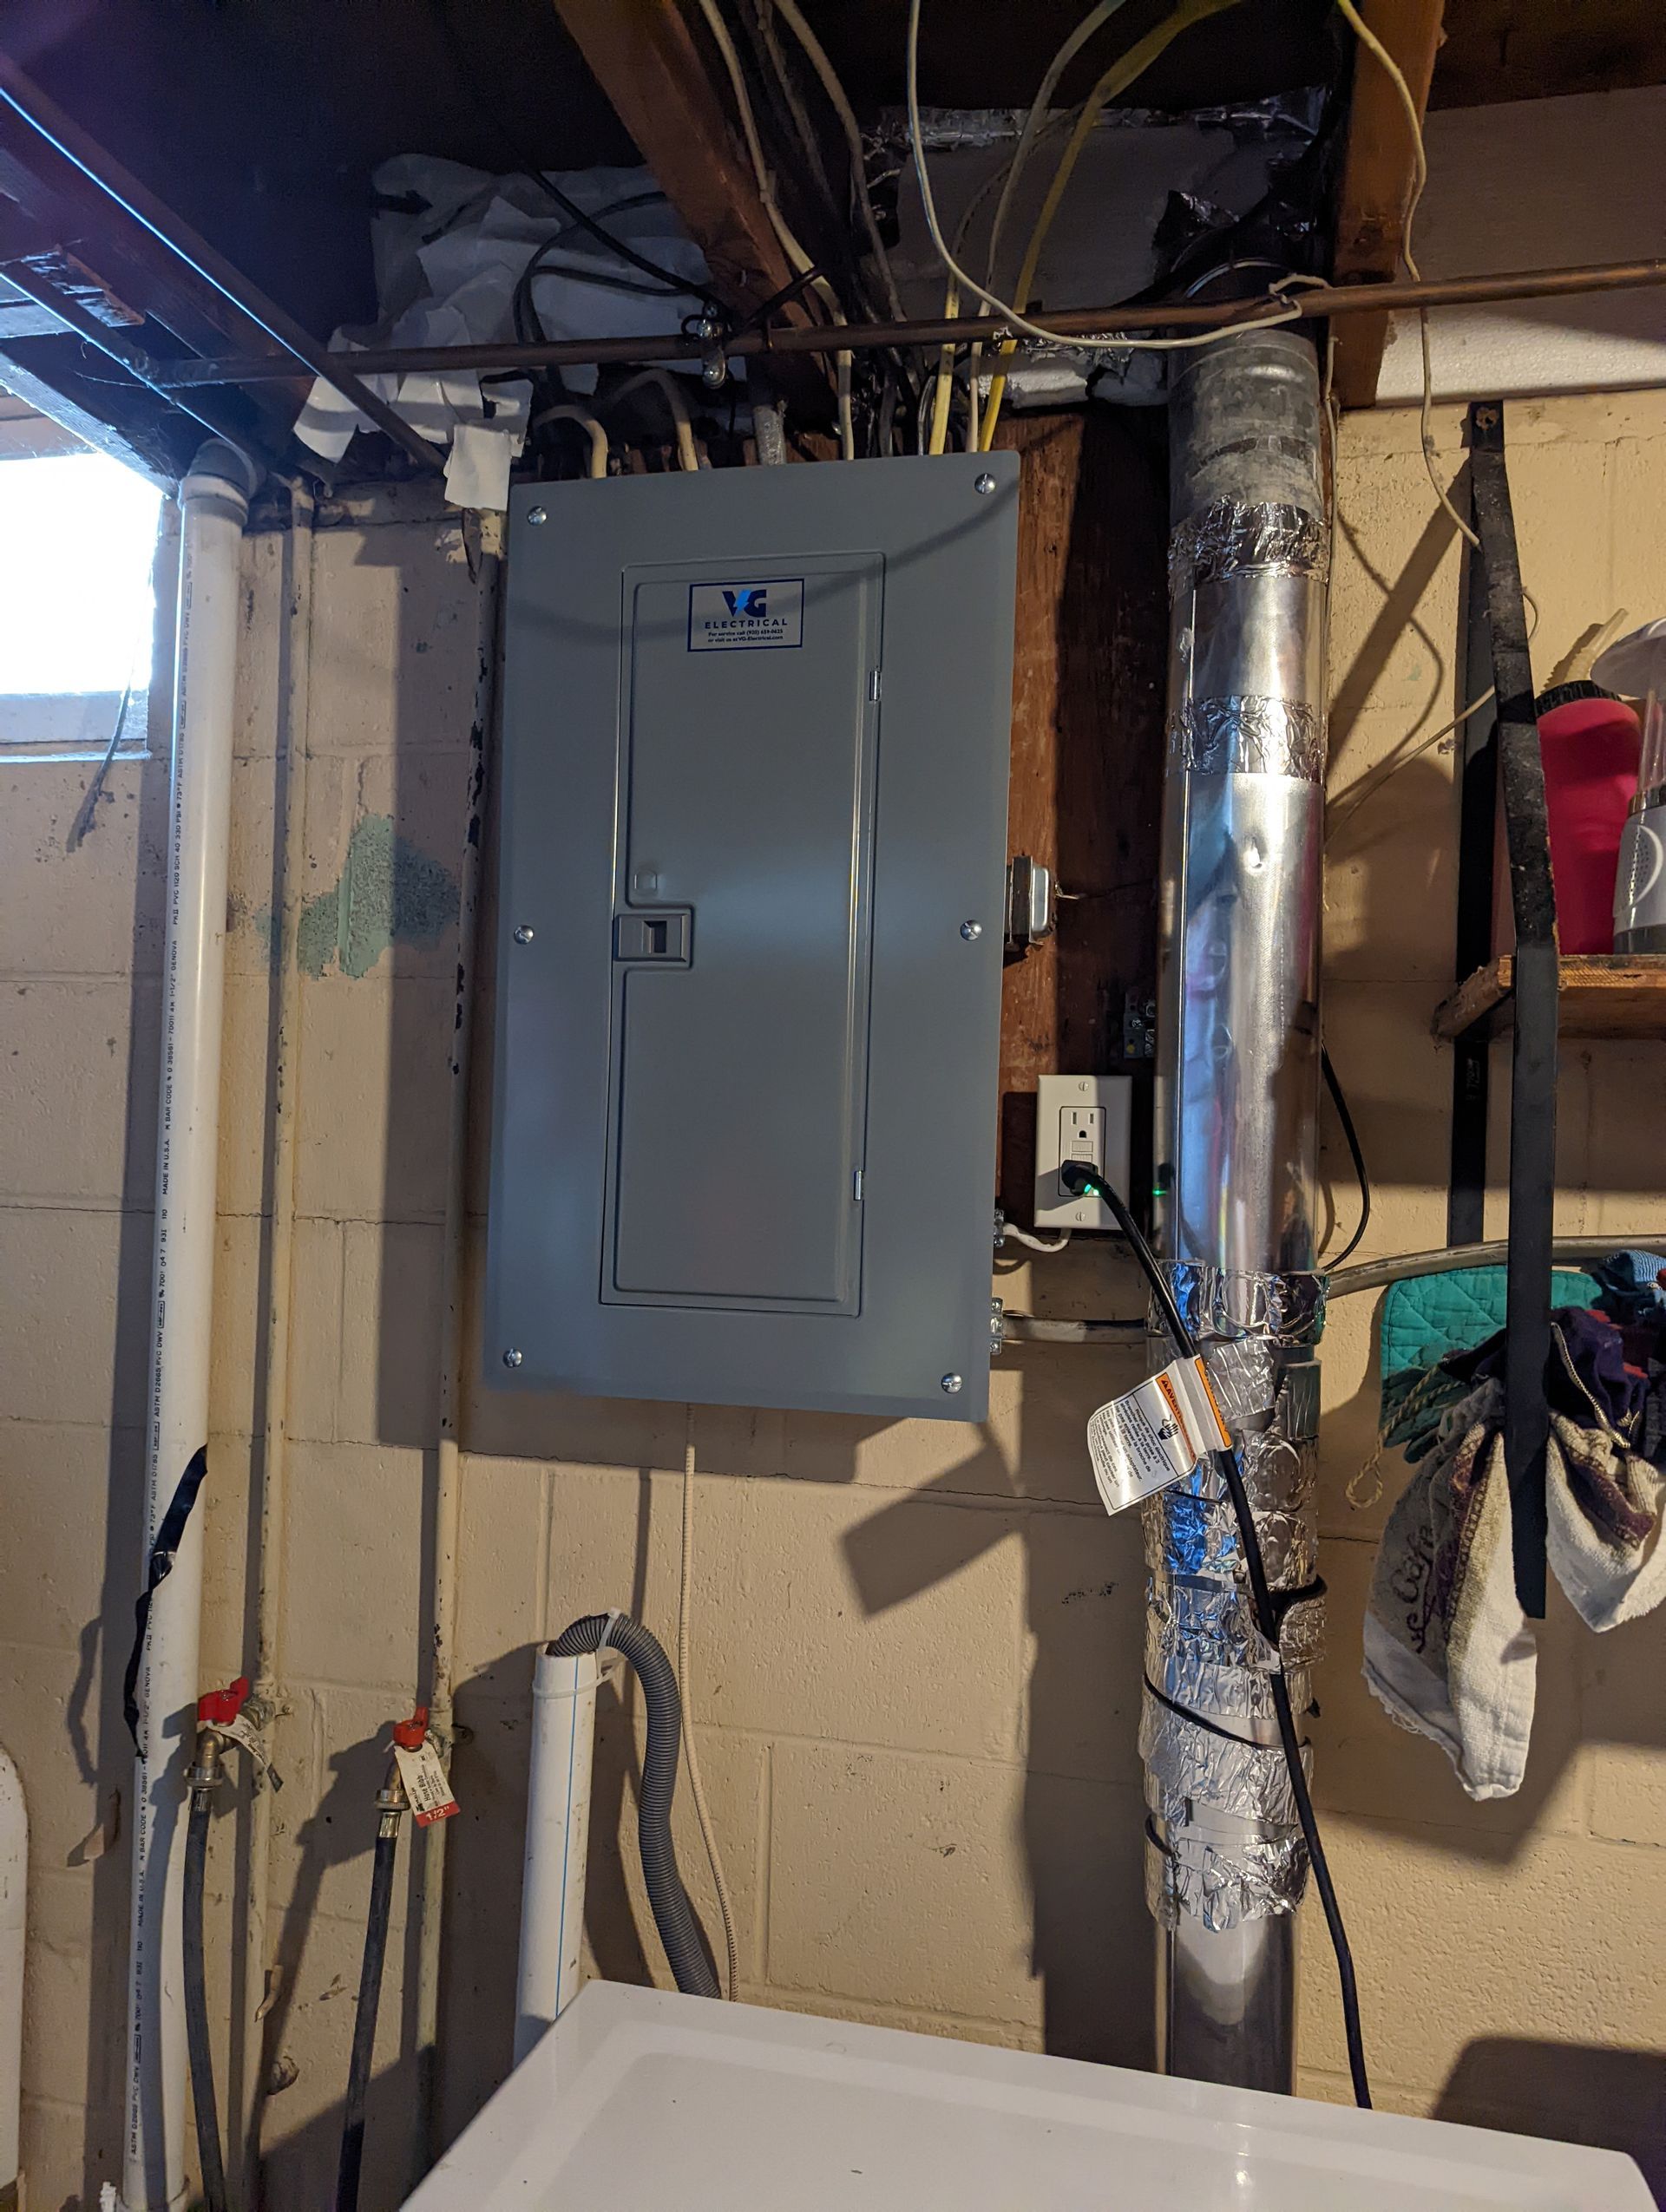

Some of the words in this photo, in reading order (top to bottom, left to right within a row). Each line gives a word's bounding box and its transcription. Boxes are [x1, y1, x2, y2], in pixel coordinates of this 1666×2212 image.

[722, 589, 767, 618] VG
[705, 618, 788, 629] ELECTRICAL
[174, 843, 180, 852] 40
[1124, 1399, 1138, 1423] Brancher
[1117, 1412, 1125, 1423] pas
[1135, 1446, 1148, 1465] broche
[1123, 1434, 1133, 1448] terre.
[1147, 1433, 1157, 1446] choc
[1154, 1446, 1171, 1471] électrique
[1125, 1452, 1143, 1482] adaptateur.
[425, 1805, 449, 1821] 1/2"
